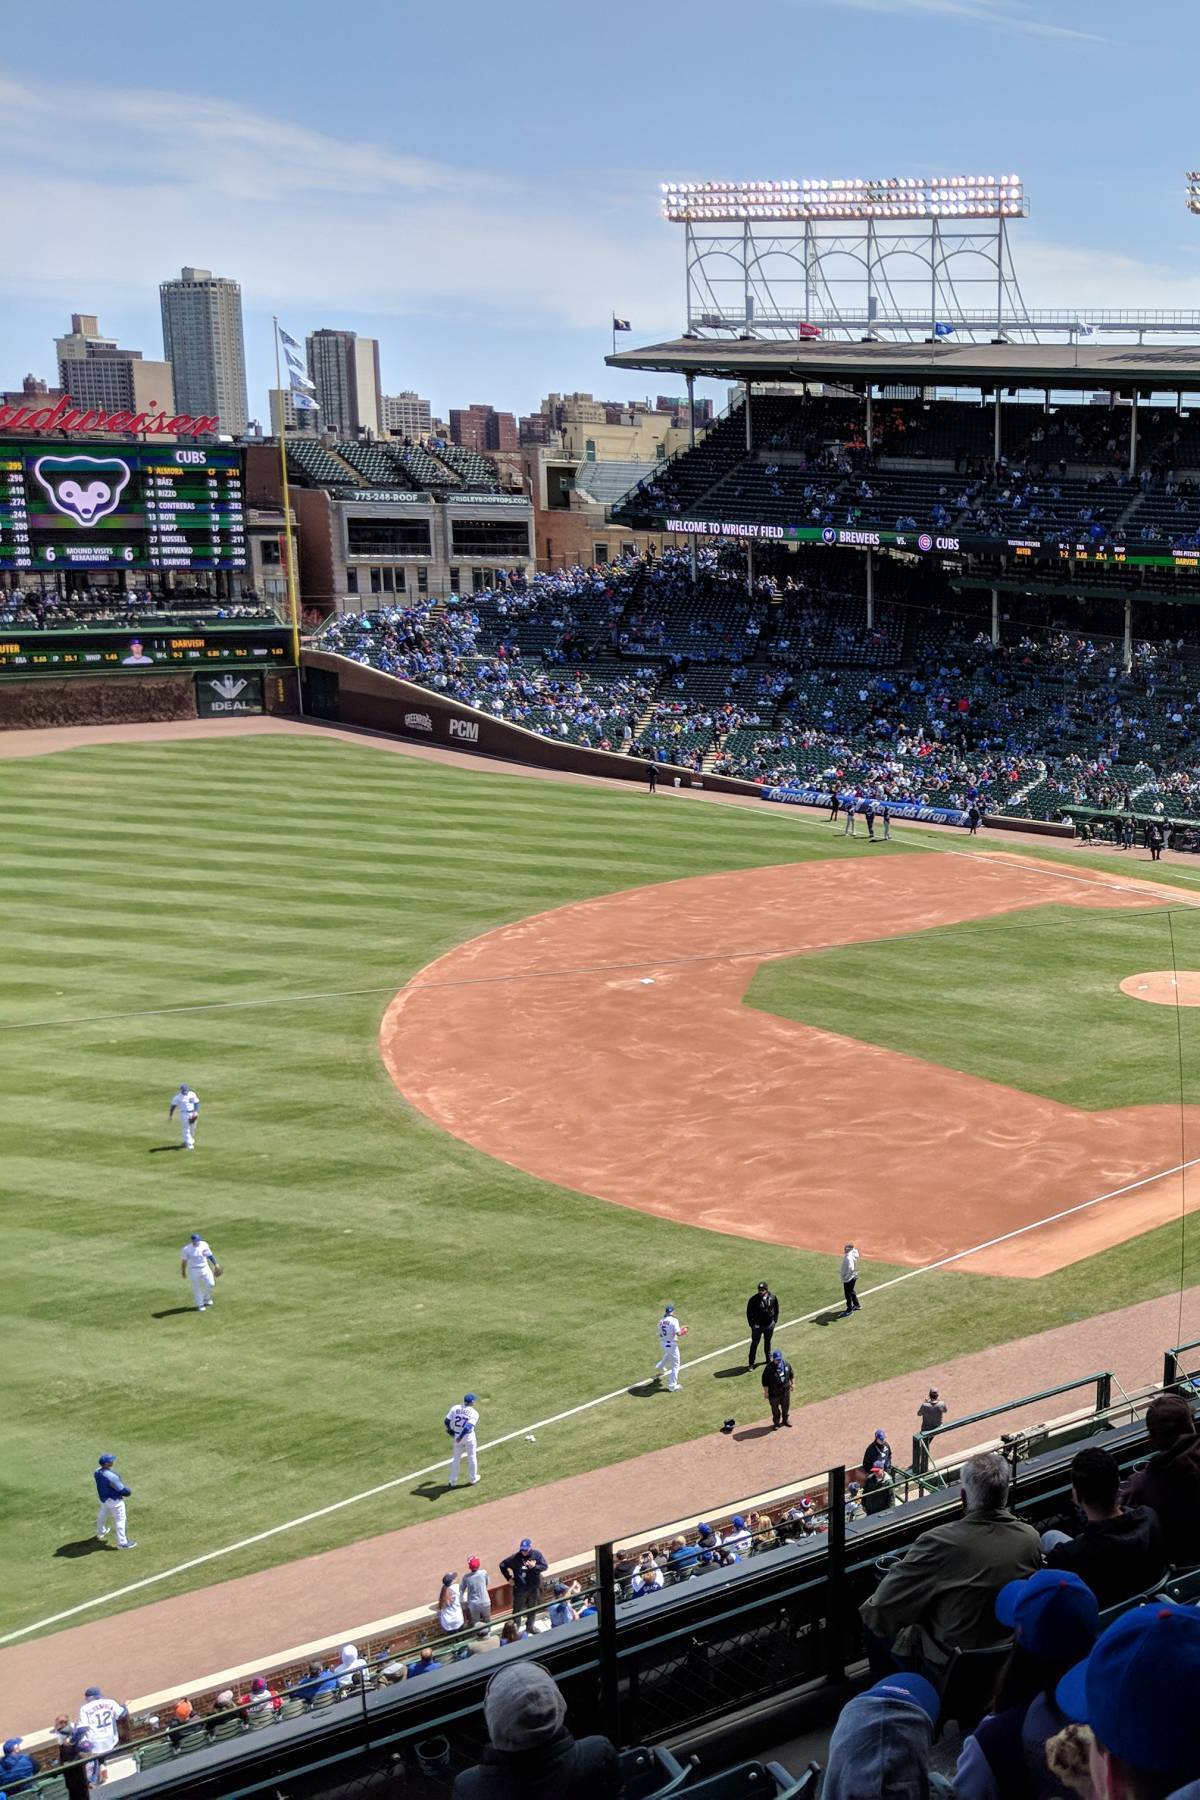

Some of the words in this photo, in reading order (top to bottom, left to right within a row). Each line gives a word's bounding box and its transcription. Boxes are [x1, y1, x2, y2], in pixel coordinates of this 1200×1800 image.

[176, 451, 207, 463] CUBS
[158, 490, 177, 498] RIZZO
[354, 491, 418, 502] 773-248-ROOF
[667, 520, 707, 533] WELCOME
[709, 522, 720, 534] TO
[722, 524, 759, 537] WRIGLEY
[761, 526, 784, 538] FIELD
[840, 531, 880, 545] BREWERS
[937, 538, 960, 550] CUBS
[46, 547, 56, 561] 6
[67, 547, 92, 555] MOUND
[124, 547, 134, 561] 6
[171, 639, 205, 649] DARVISH
[212, 702, 250, 711] IDEAL
[449, 719, 479, 739] PCM
[768, 789, 816, 804] Reynolds
[917, 808, 947, 823] Wrap
[455, 1416, 468, 1428] 27
[96, 1711, 111, 1728] 12
